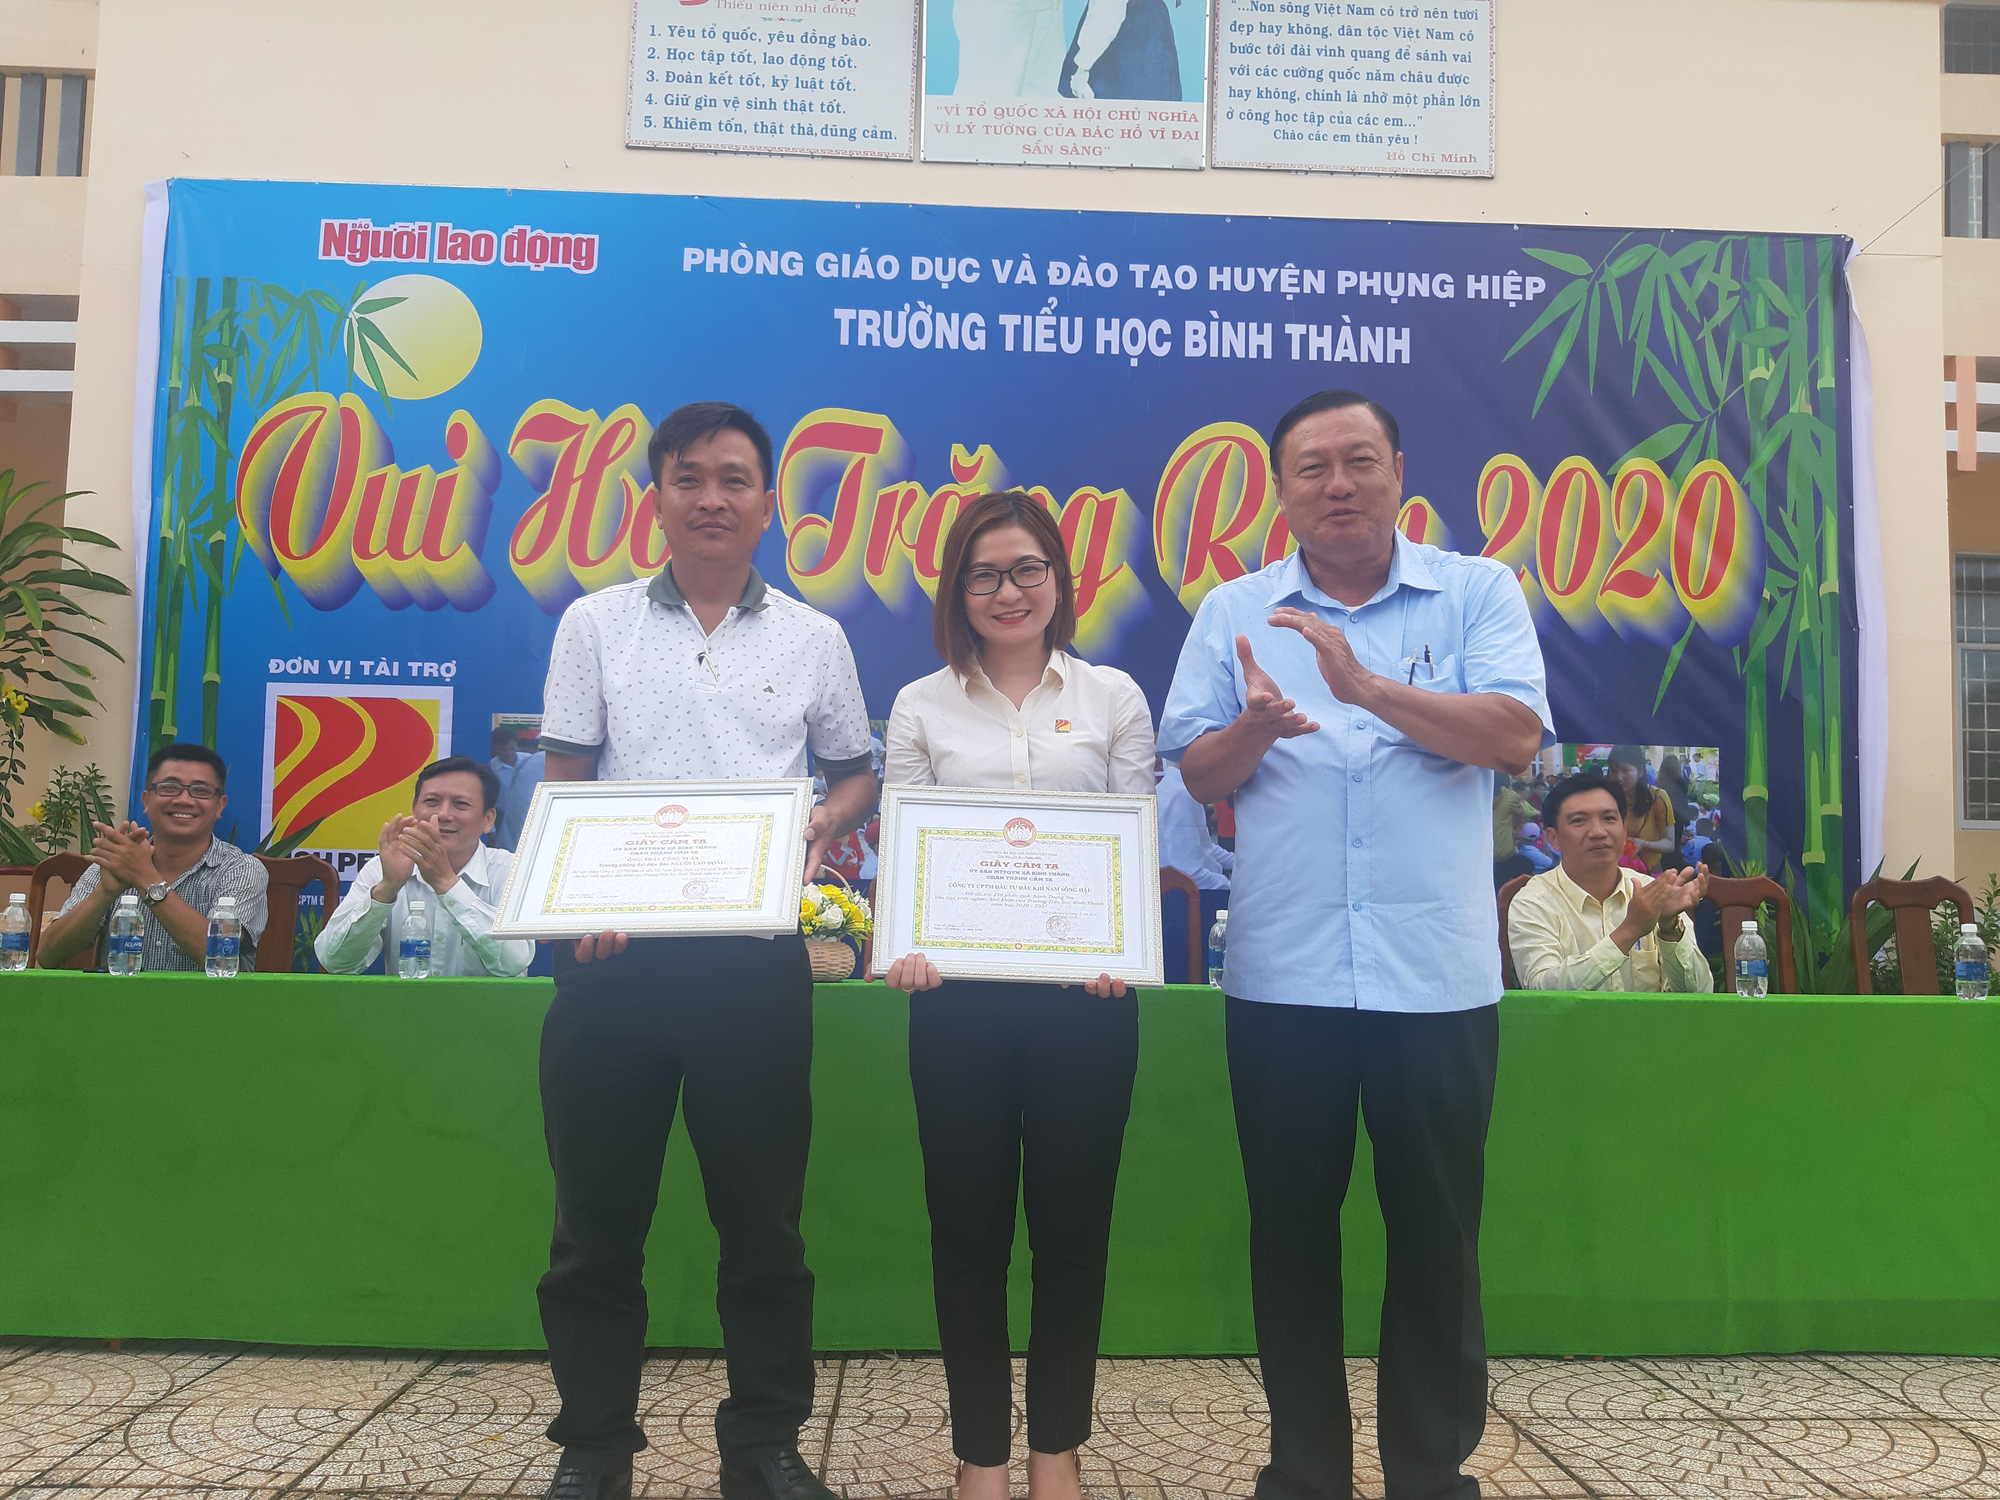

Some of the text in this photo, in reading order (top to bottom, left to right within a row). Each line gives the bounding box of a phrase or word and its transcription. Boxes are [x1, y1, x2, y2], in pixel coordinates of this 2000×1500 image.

[759, 2, 788, 11] niên
[795, 3, 816, 13] nhi
[1280, 2, 1310, 17] sông
[1314, 3, 1341, 17] Việt
[1347, 4, 1375, 16] Nam
[1380, 6, 1394, 16] có
[1400, 5, 1419, 18] trở
[1424, 8, 1448, 19] nên
[1453, 9, 1478, 20] tươi
[650, 23, 870, 48] 1. Yêu tổ quốc, yêu đồng bào.
[1230, 20, 1474, 41] đẹp hay không, dân tộc Việt Nam có
[647, 47, 856, 71] 2. Học tập tốt, lao động tốt.
[1230, 42, 1472, 63] bước tới đài vinh quang để sánh vai
[646, 70, 856, 92] 3. Đoàn kết tốt, kỷ luật tốt.
[1229, 64, 1469, 87] với các cường quốc năm châu được
[645, 93, 845, 114] 4. Giữ gìn vệ sinh thật tốt.
[1229, 86, 1480, 108] hay không, chính là nhờ một phần lớn
[966, 101, 986, 116] TỔ
[994, 103, 1038, 120] QUỐC
[1044, 106, 1066, 118] XÃ
[1073, 107, 1101, 122] HỘI
[1108, 107, 1140, 120] CHỦ
[1148, 110, 1198, 122] NGHĨA
[1226, 107, 1234, 120] ở
[1239, 109, 1270, 125] công
[1275, 110, 1298, 124] học
[1304, 111, 1324, 126] tập
[1330, 111, 1352, 124] của
[1357, 113, 1378, 126] các
[644, 116, 656, 128] 5.
[663, 117, 712, 131] Khiêm
[718, 117, 746, 134] tốn,
[754, 121, 784, 137] thật
[862, 125, 896, 140] cảm.
[934, 122, 949, 134] VÌ
[956, 122, 976, 134] LÝ
[982, 122, 1037, 136] TƯỞNG
[1044, 123, 1076, 137] CỦA
[1082, 126, 1114, 138] BÁC
[1120, 124, 1142, 139] HỒ
[1172, 130, 1199, 142] ĐẠI
[1274, 129, 1303, 140] Chào
[1308, 130, 1328, 141] các
[1333, 134, 1350, 142] em
[1356, 132, 1383, 143] thân
[1388, 134, 1409, 146] yêu
[1022, 140, 1053, 154] SẴN
[1386, 150, 1477, 163] Hồ Chí Minh
[322, 221, 596, 271] Người lao động
[683, 242, 1547, 308] PHÒNG GIÁO DỤC VÀ ĐÀO TẠO HUYỆN PHỤNG HIỆP
[834, 296, 1411, 367] TRƯỜNG TIỂU HỌC BÌNH THÀNH
[236, 391, 472, 580] Vui
[1477, 453, 1750, 610] 2020
[268, 656, 457, 681] ĐƠN VỊ TÀI TRỢ
